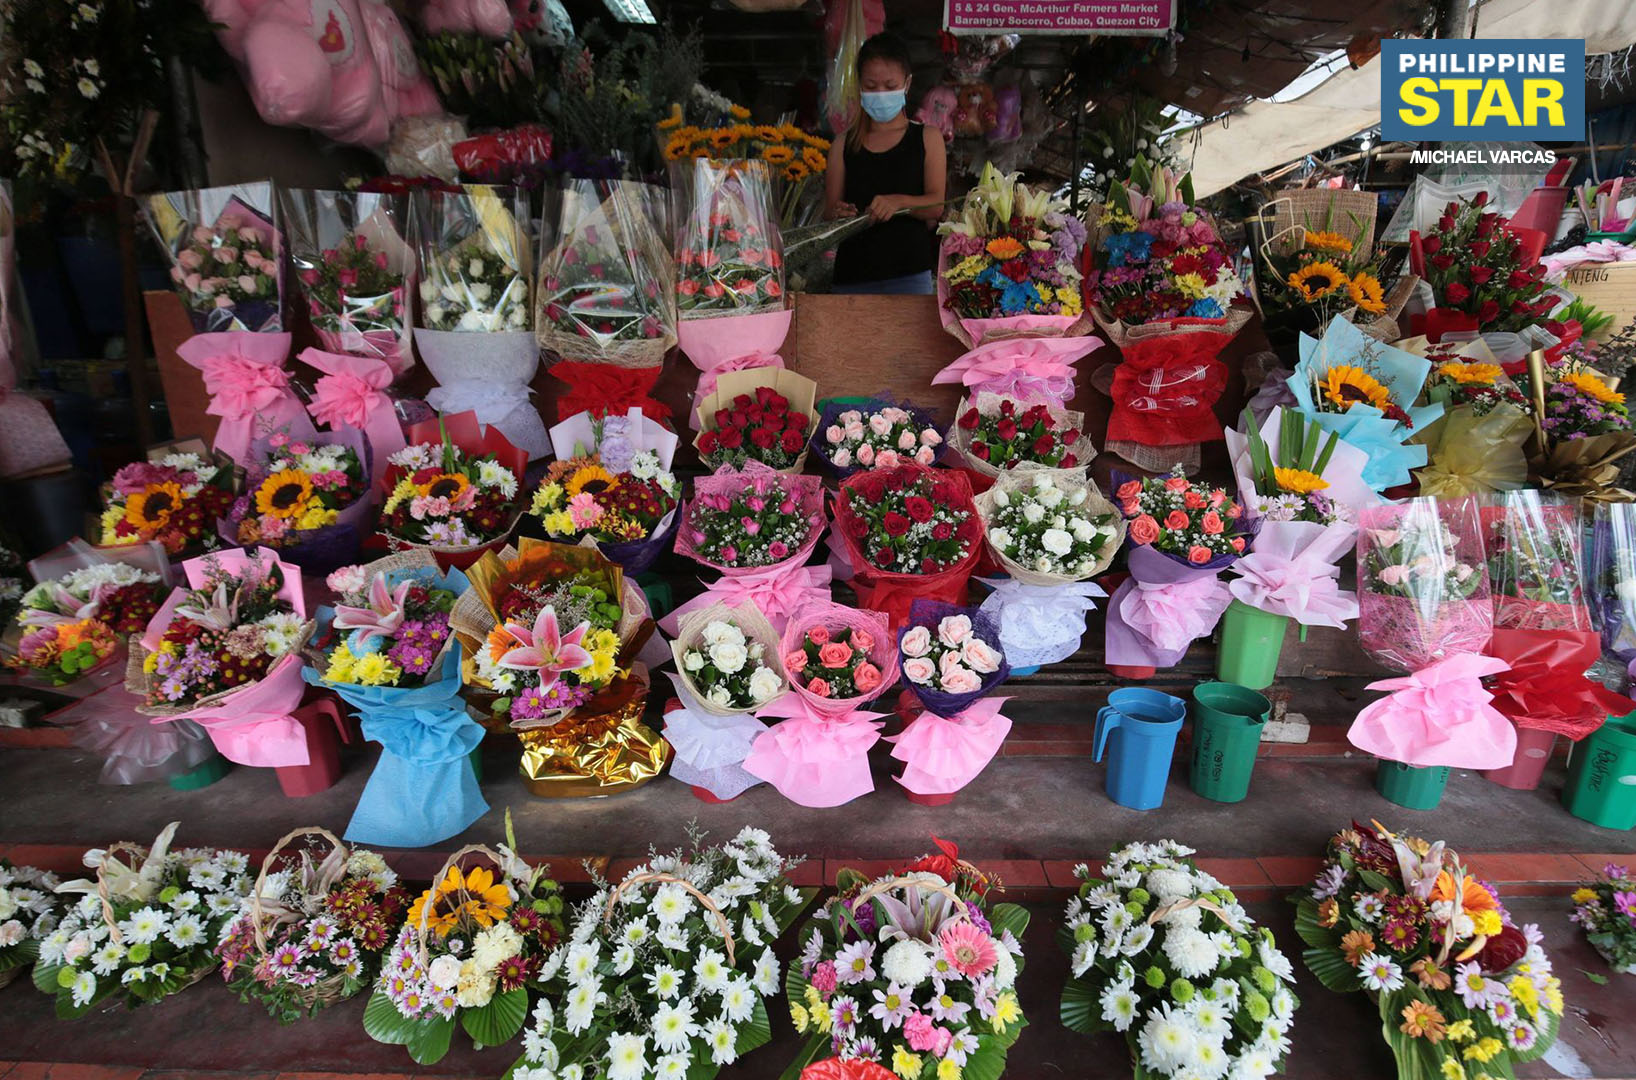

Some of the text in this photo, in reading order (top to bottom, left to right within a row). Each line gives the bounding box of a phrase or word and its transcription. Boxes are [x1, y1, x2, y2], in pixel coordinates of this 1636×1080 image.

[955, 3, 1158, 13] 5 & 24 Gen. McArthur Farmers Market
[954, 16, 1160, 27] Barangay Socorro, Cubao, Quezon City
